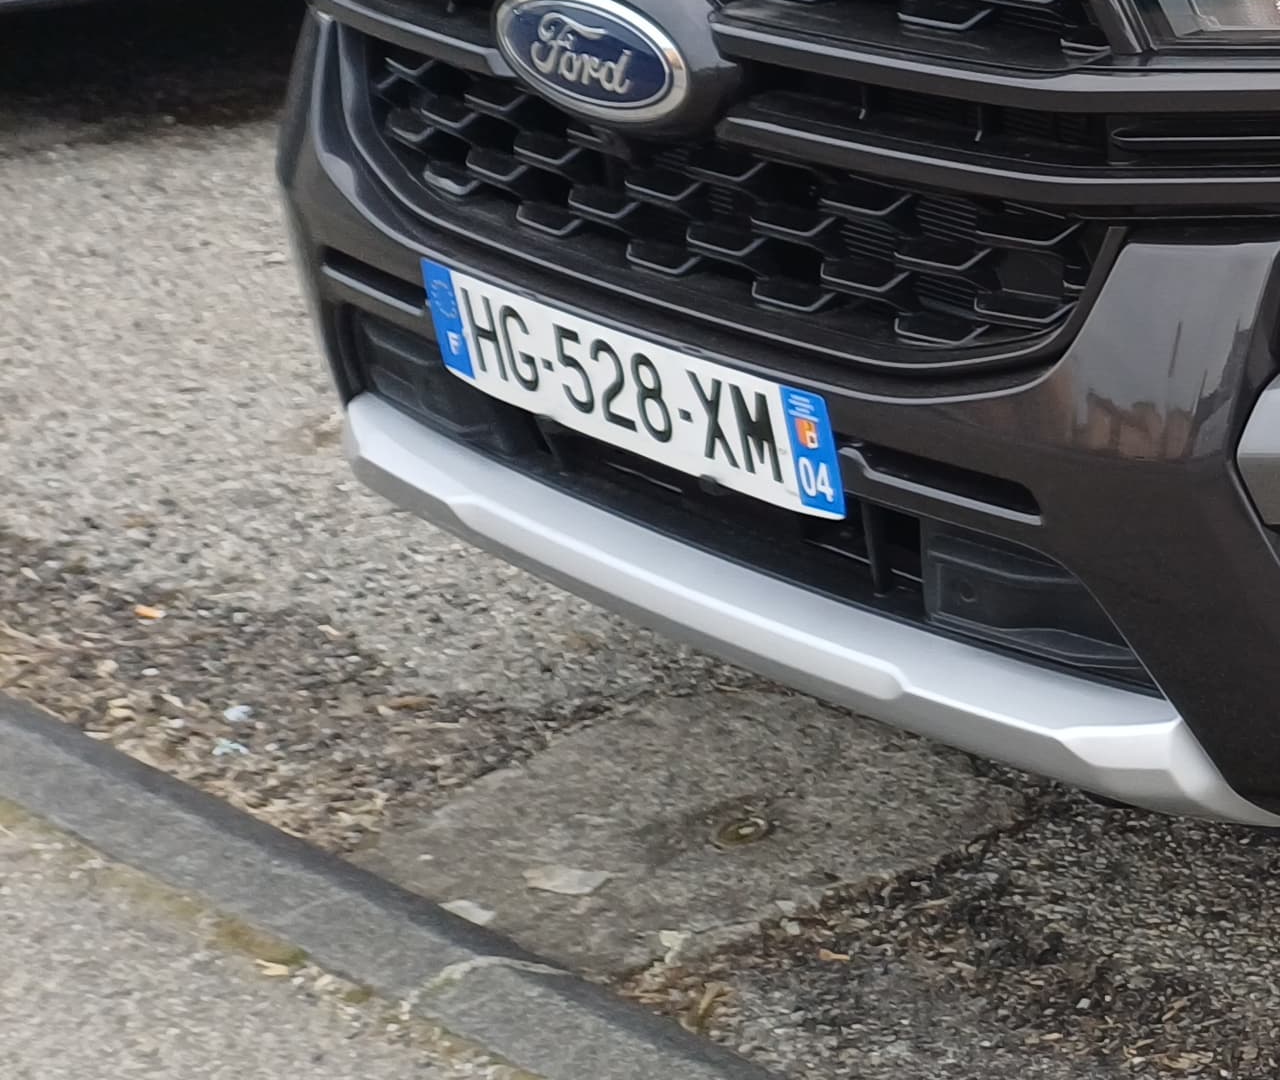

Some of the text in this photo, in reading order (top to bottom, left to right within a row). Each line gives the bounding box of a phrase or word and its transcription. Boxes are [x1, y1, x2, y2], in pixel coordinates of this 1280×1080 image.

[530, 12, 633, 94] Ford
[460, 286, 784, 484] HG-528-XM
[798, 457, 835, 503] 04
